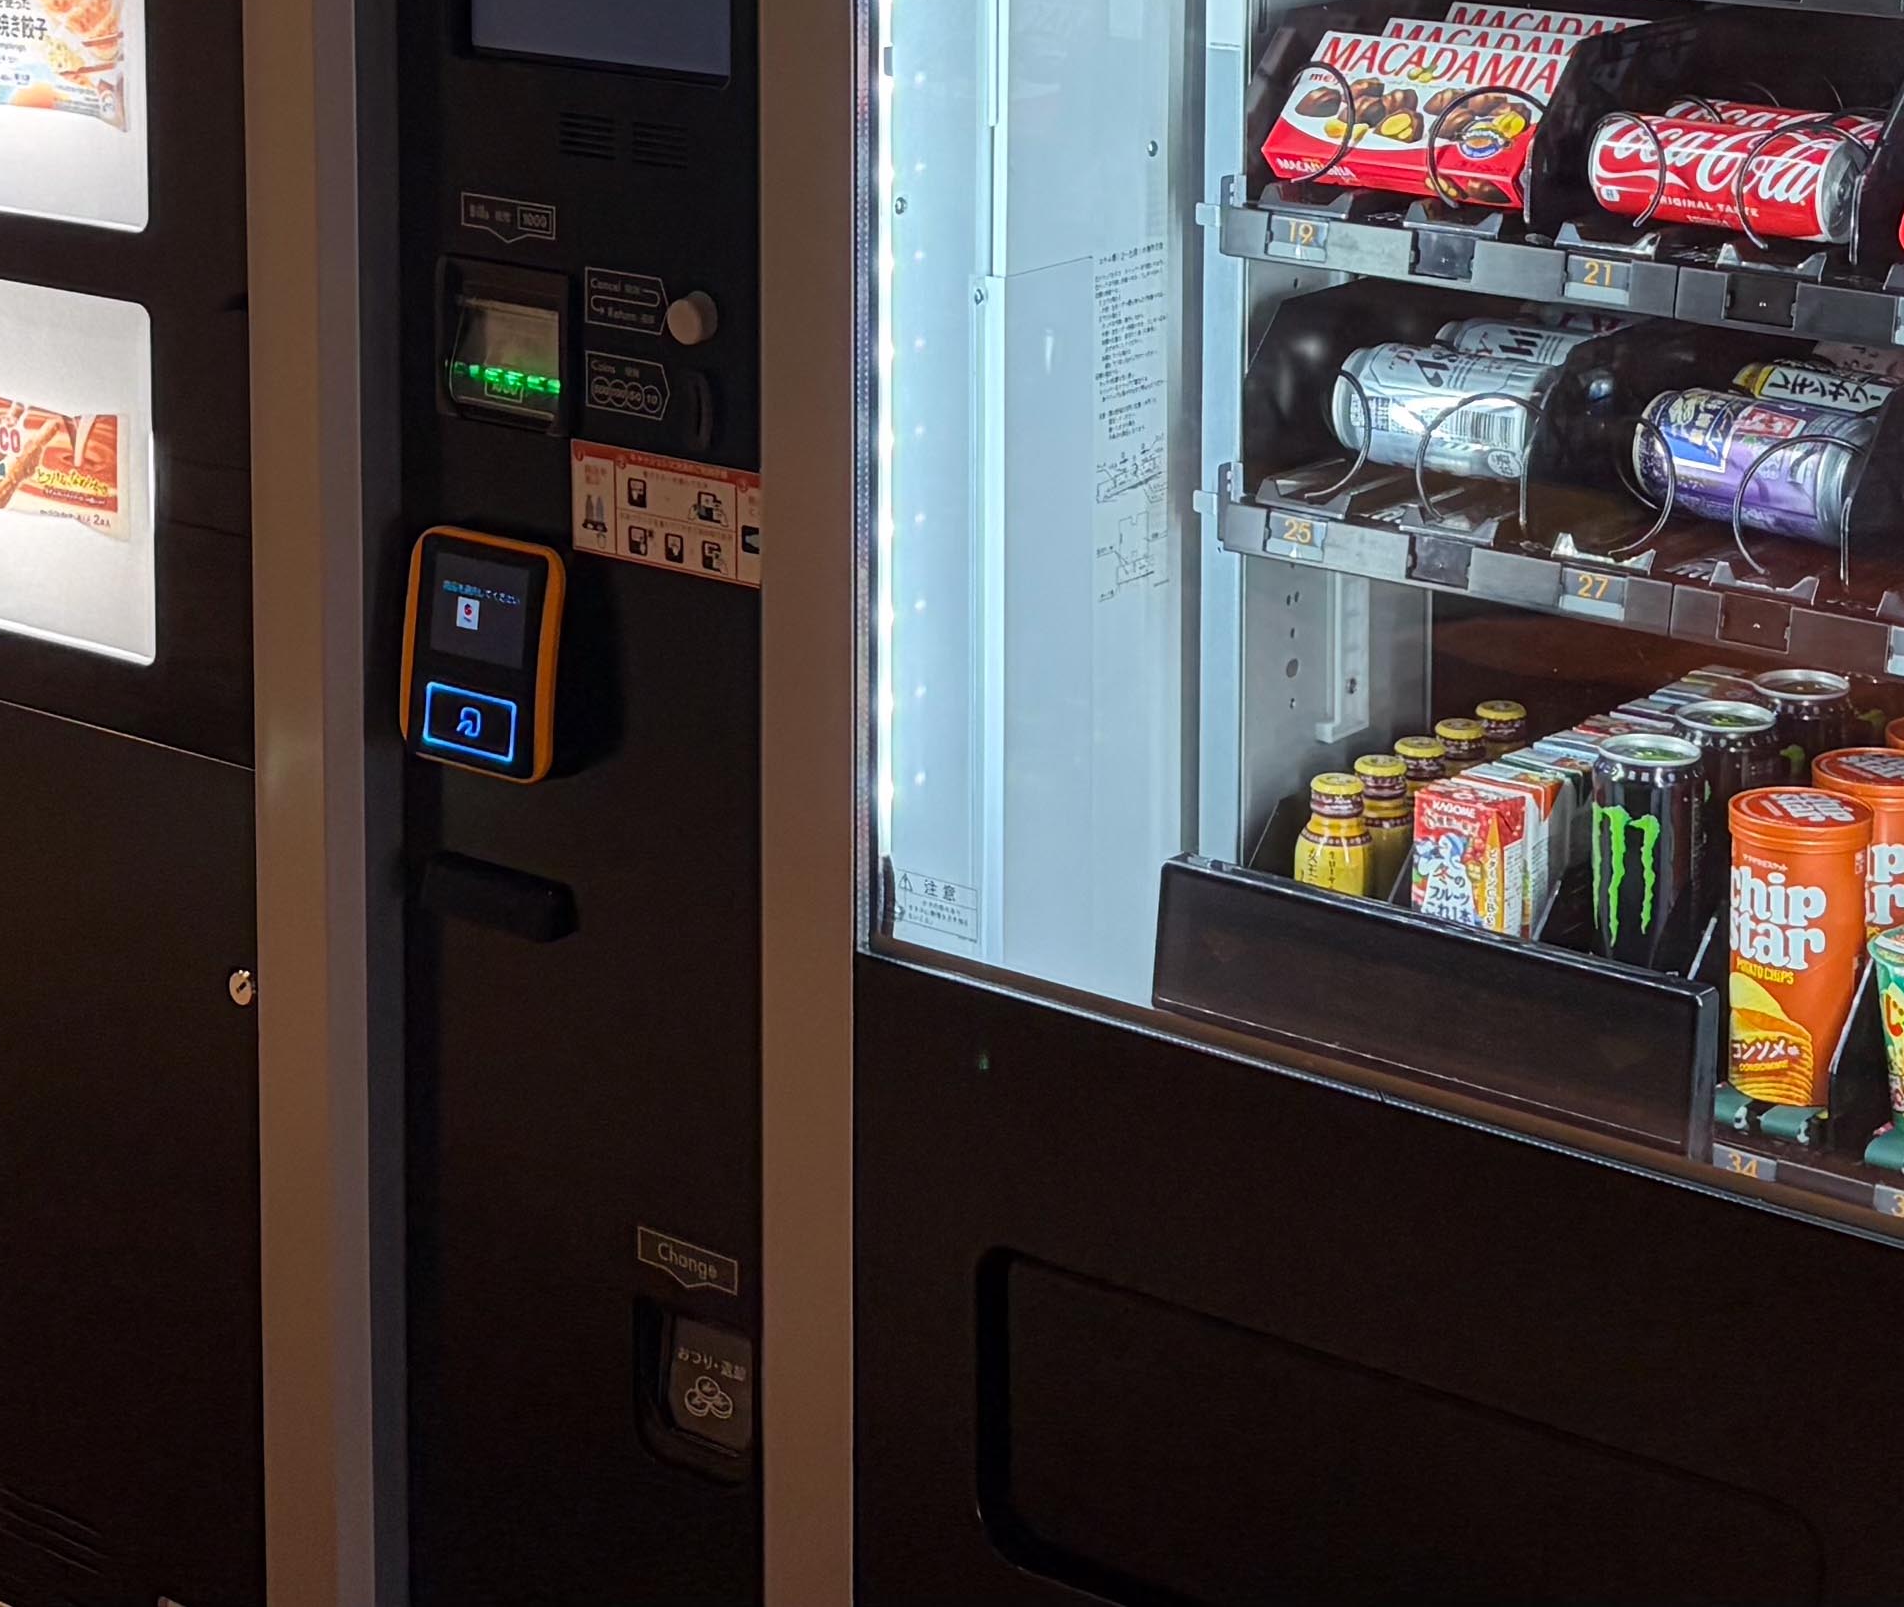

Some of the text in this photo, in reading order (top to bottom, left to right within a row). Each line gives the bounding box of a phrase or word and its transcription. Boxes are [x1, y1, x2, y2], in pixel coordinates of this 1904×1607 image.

[1320, 36, 1560, 95] MACADAMIA
[1596, 114, 1823, 205] Coca-Cola
[1718, 203, 1760, 218] TATE
[1288, 220, 1314, 245] 19
[1583, 261, 1613, 288] 21
[1284, 519, 1312, 545] 25
[1578, 575, 1609, 600] 27
[923, 878, 956, 902] 注意
[1730, 865, 1827, 927] Chip
[1764, 965, 1795, 986] CHIPS
[1726, 1151, 1759, 1178] 34
[656, 1242, 718, 1281] Change
